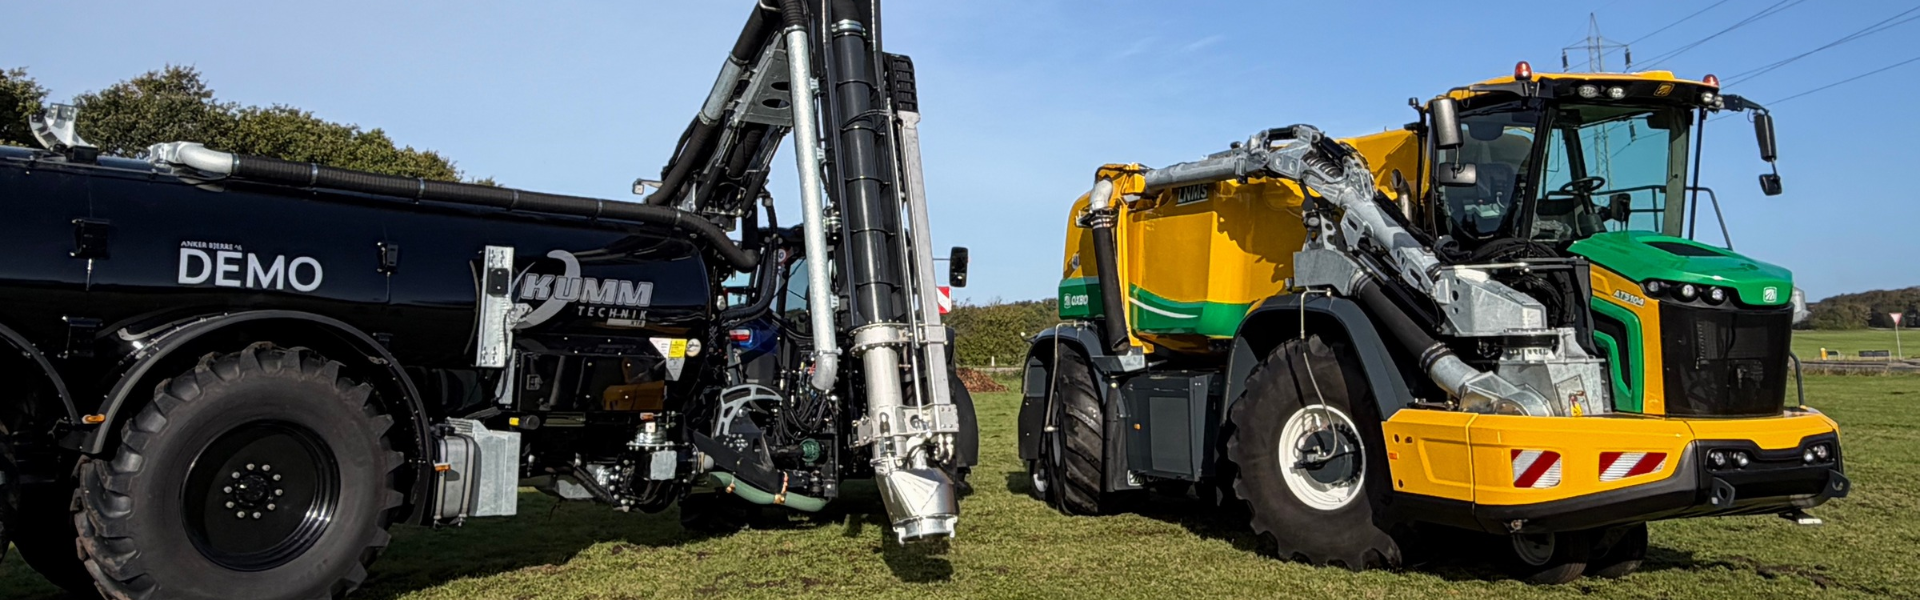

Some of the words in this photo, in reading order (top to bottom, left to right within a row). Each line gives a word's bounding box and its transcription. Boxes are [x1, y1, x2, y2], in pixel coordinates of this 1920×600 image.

[1178, 184, 1208, 203] LNMS
[181, 241, 207, 249] ANKER
[209, 242, 233, 250] BJERRE
[178, 247, 323, 292] DEMO
[521, 273, 654, 307] KUMM
[1613, 290, 1644, 306] AT5104
[1071, 294, 1089, 306] OXBO
[578, 306, 648, 319] TECHNIK
